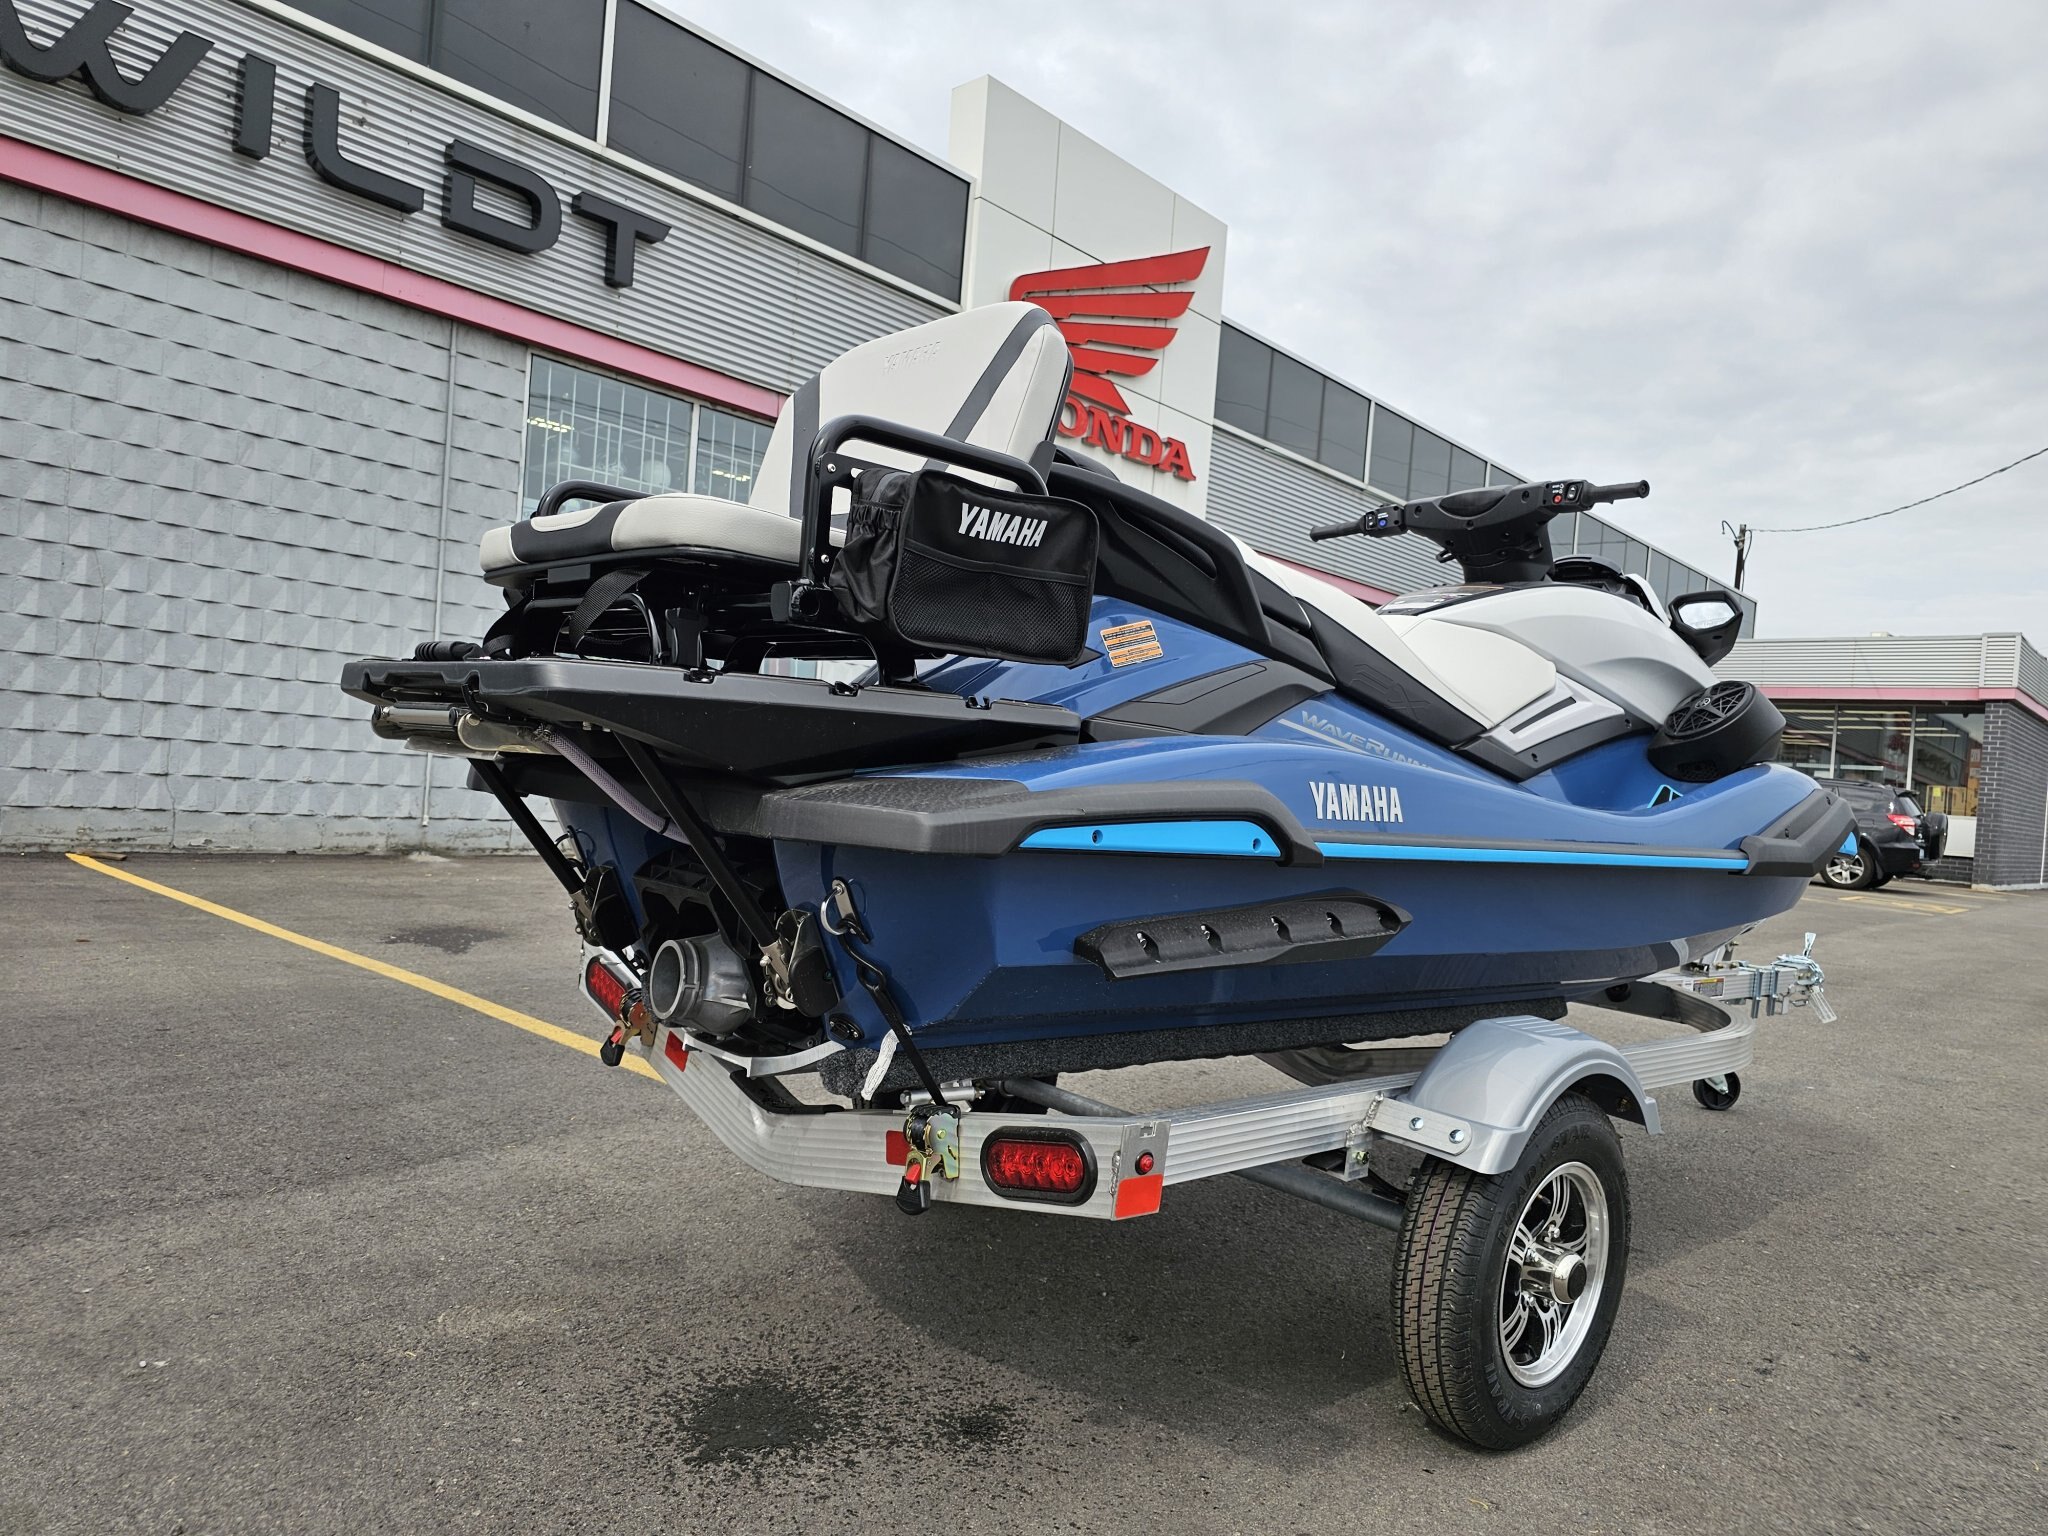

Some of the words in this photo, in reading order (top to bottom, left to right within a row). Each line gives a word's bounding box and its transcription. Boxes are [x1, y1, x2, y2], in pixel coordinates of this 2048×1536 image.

[0, 0, 671, 289] WILDT
[1057, 395, 1197, 482] ONDA
[958, 502, 1048, 548] YAMAHA
[1309, 781, 1404, 823] YAMAHA
